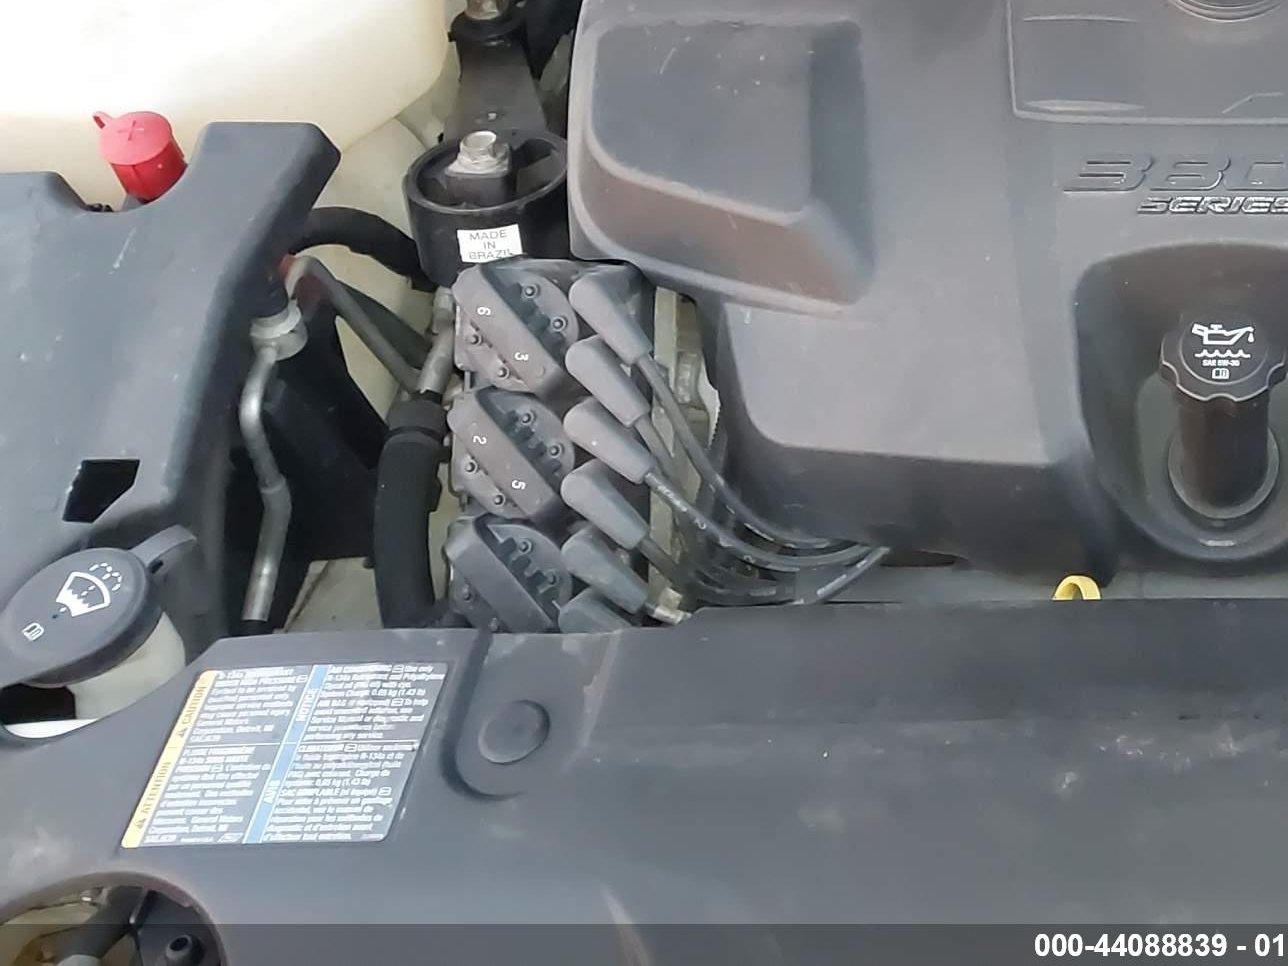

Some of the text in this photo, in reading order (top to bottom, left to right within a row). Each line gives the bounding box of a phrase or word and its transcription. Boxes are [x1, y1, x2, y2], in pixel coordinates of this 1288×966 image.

[469, 229, 508, 241] MADE
[483, 240, 496, 251] IN
[468, 248, 513, 260] BRAZIL
[514, 352, 529, 361] 3
[472, 435, 487, 445] 2
